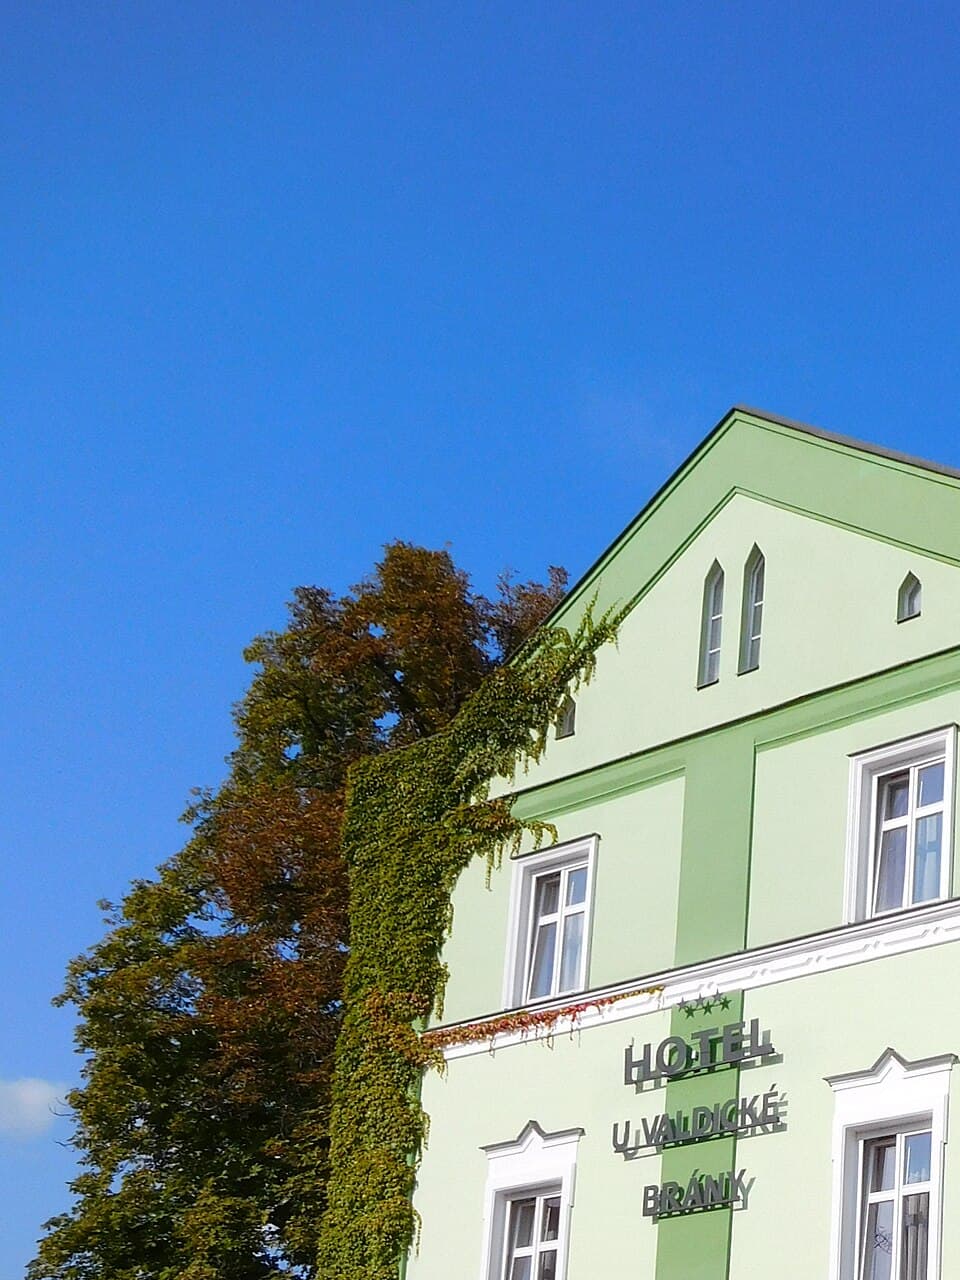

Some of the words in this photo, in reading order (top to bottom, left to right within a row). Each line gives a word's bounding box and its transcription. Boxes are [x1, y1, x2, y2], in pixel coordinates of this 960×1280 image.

[624, 1018, 774, 1086] HOTEL
[612, 1120, 630, 1151] U
[641, 1083, 780, 1146] VALDICKÉ
[642, 1169, 746, 1217] BRÁNY
